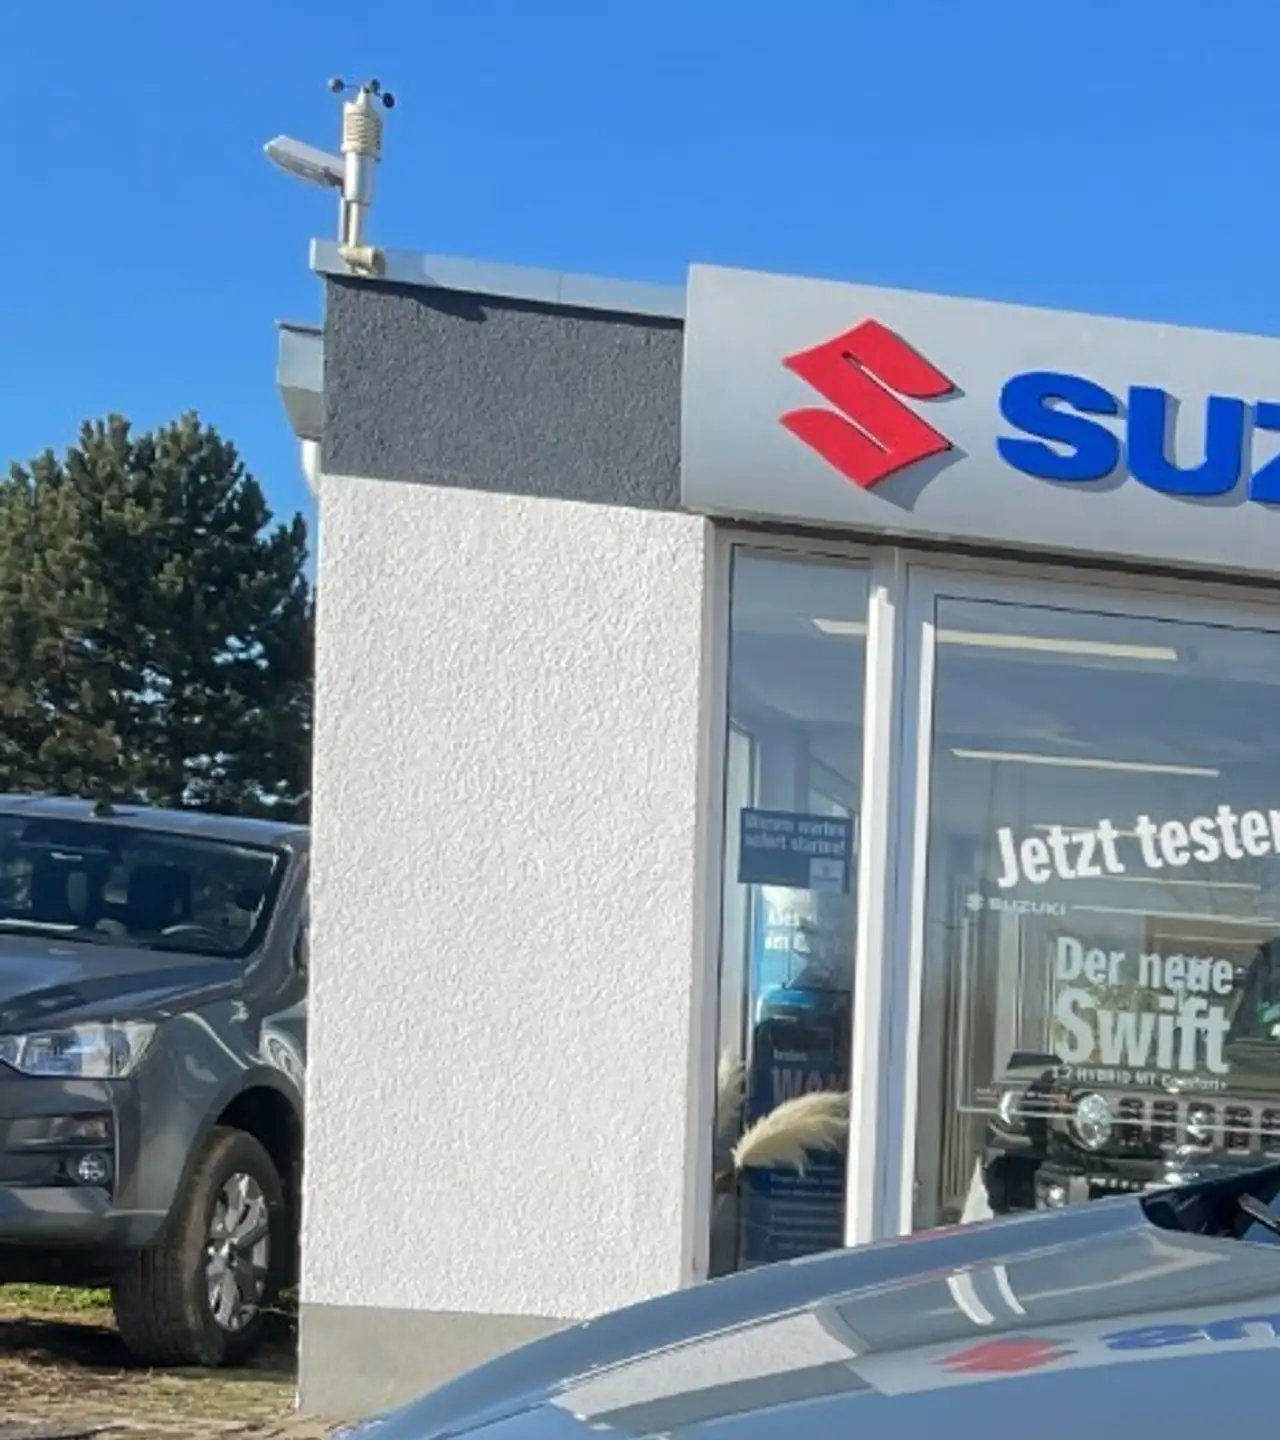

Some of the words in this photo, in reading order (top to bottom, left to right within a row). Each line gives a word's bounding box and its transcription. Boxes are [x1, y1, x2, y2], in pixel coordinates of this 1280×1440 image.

[996, 819, 1126, 888] Jetzt
[989, 898, 1066, 916] SUZUKI
[1054, 936, 1125, 985] Der
[1138, 951, 1234, 995] neue
[1053, 988, 1232, 1074] Swift
[1076, 1067, 1131, 1085] HYBRID
